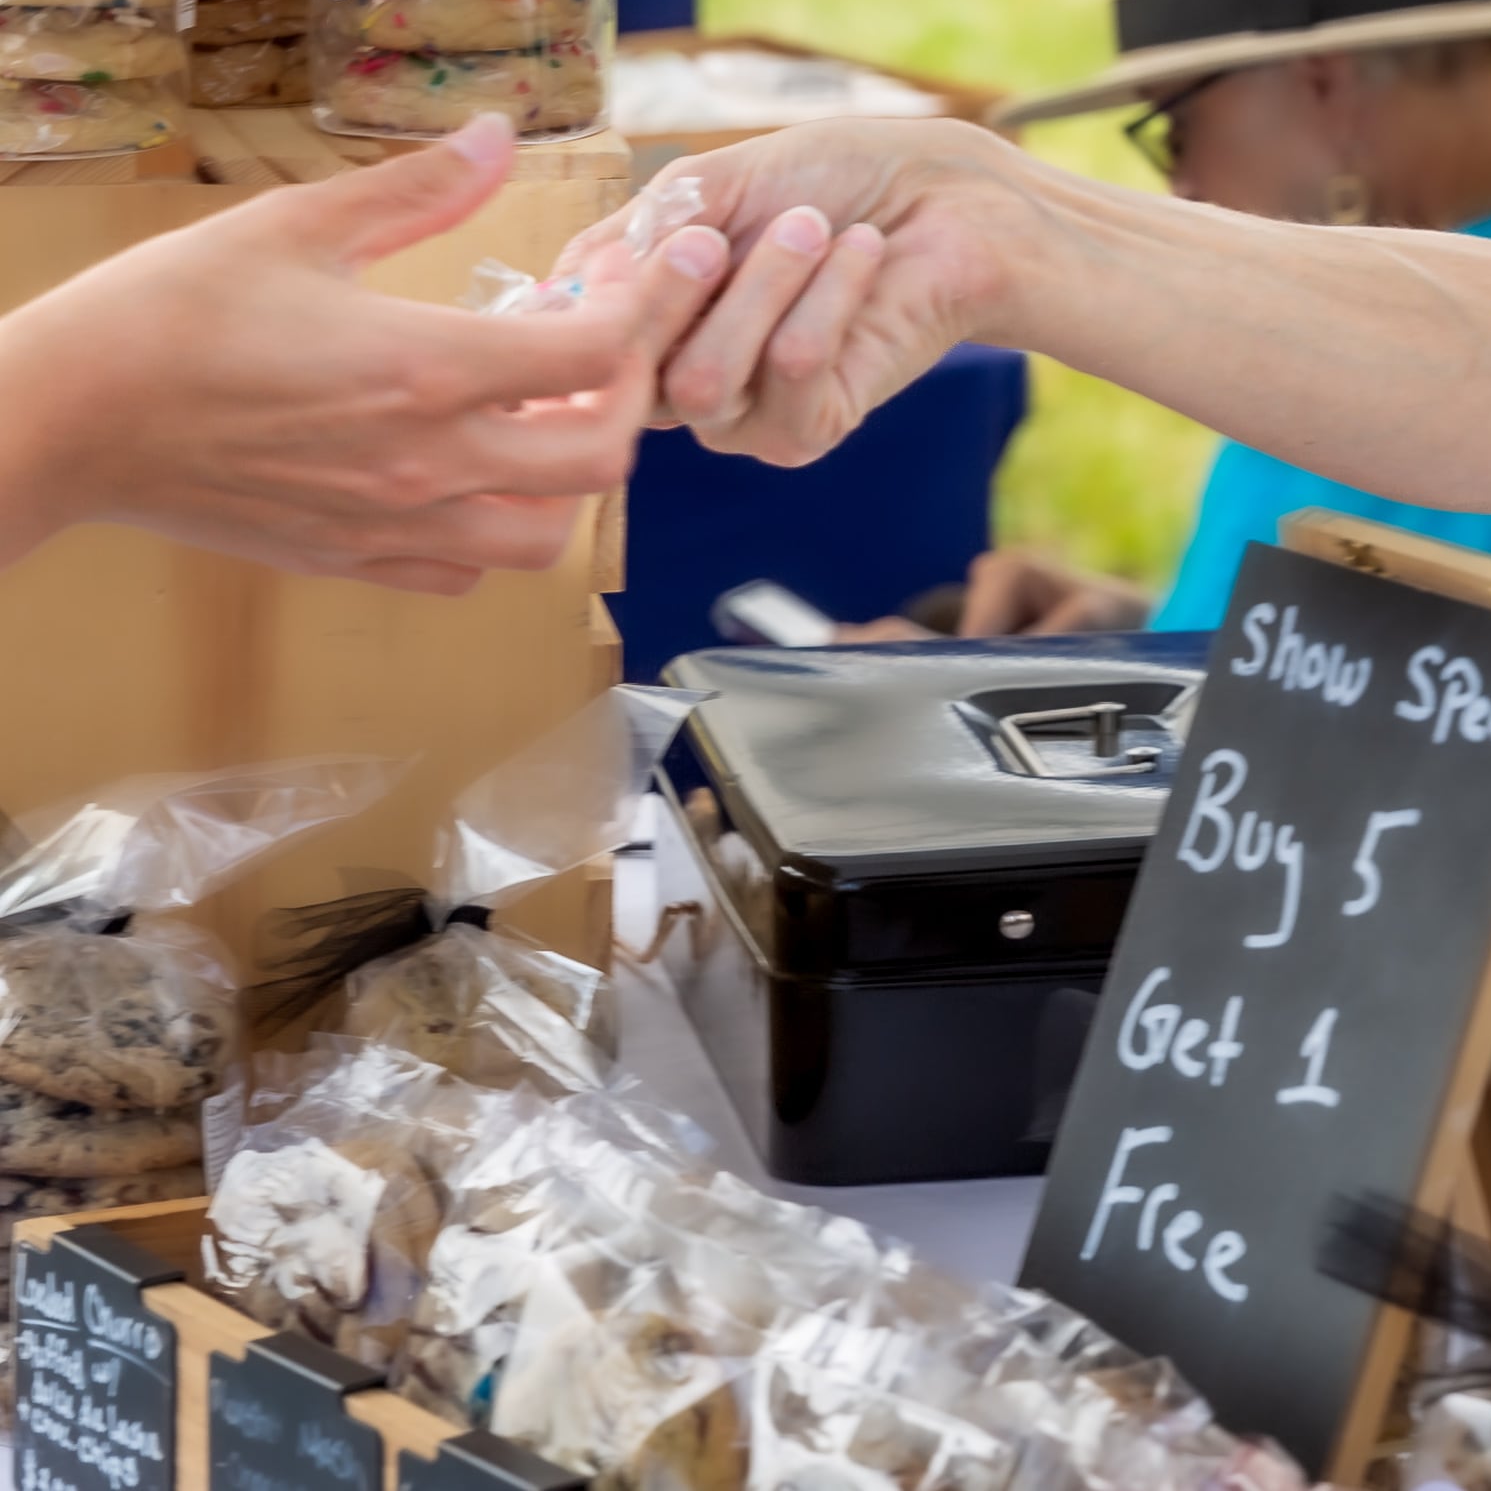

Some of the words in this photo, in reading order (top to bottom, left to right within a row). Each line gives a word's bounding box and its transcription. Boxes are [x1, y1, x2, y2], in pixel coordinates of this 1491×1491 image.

[1230, 602, 1373, 706] Show
[1176, 747, 1304, 949] Buy
[1341, 807, 1423, 918] 5
[1116, 966, 1246, 1088] Get
[1275, 1006, 1343, 1109] 1
[1080, 1124, 1251, 1304] Free
